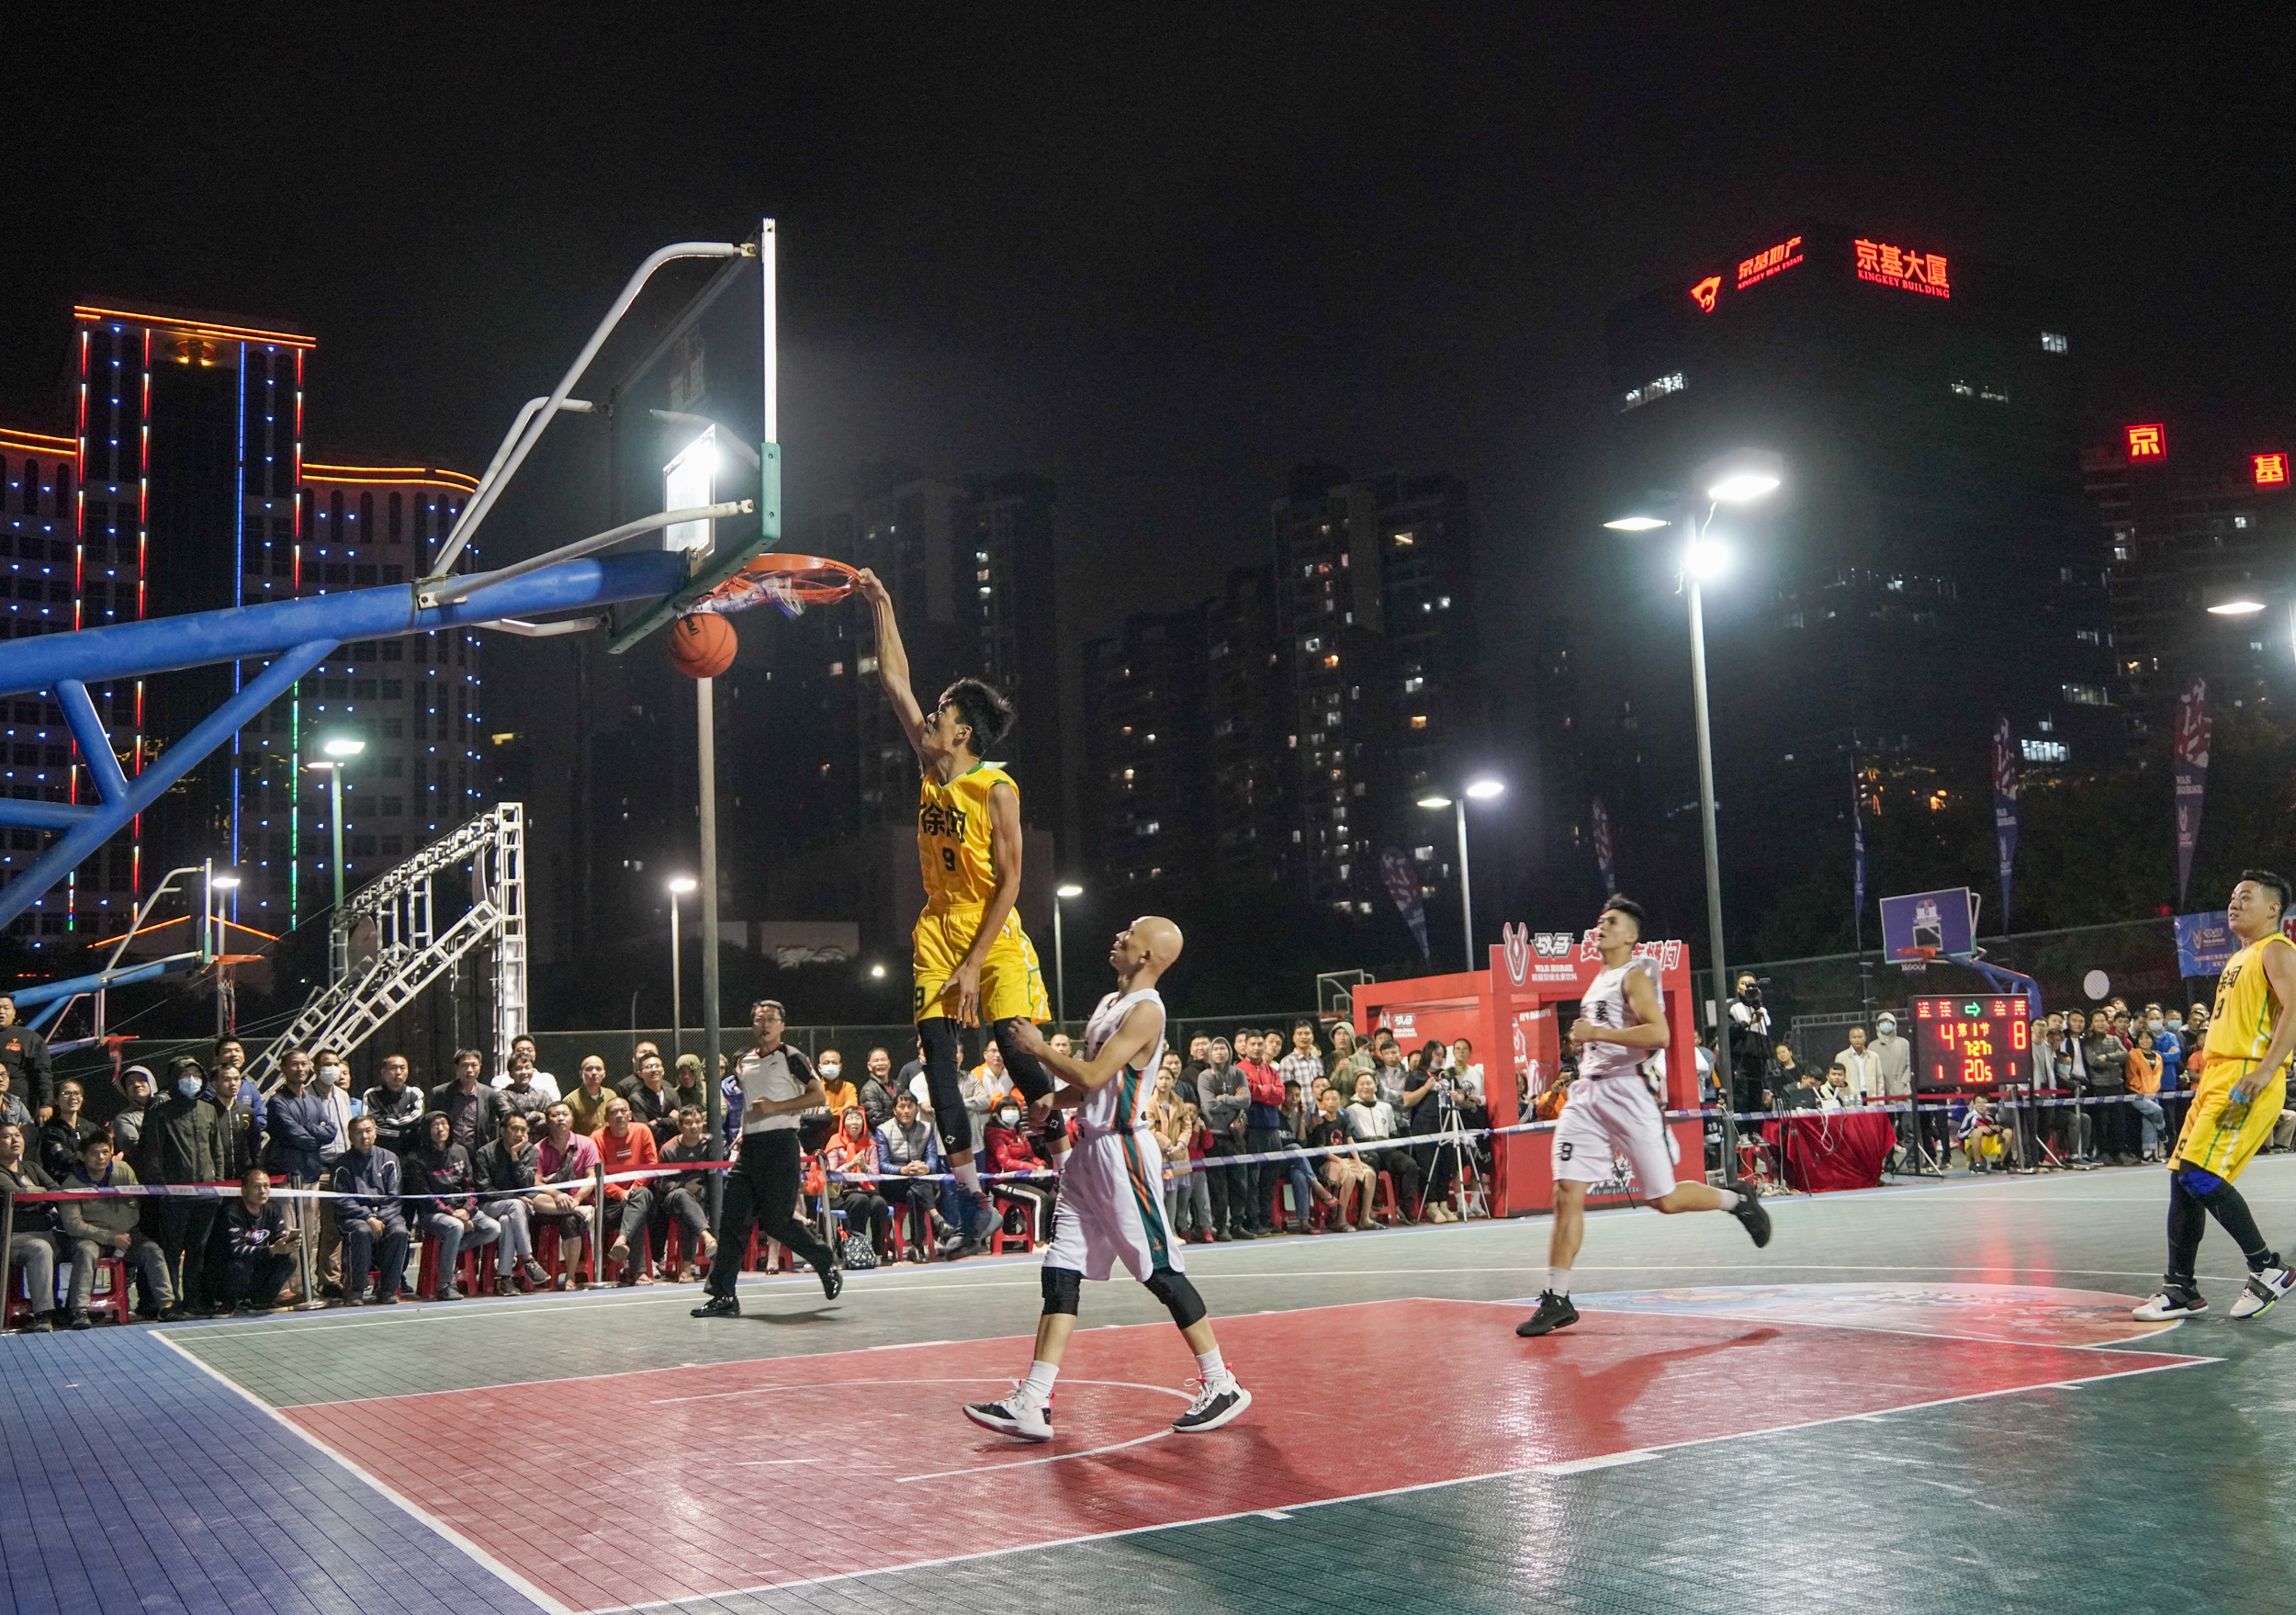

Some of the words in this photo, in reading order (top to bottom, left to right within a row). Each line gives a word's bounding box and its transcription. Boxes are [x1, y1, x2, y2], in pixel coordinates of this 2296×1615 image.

[1738, 235, 1802, 279] 京基地产
[1738, 269, 1766, 289] KINGKEY
[1782, 254, 1804, 271] ESTATE
[1854, 238, 1950, 288] 京基大厦
[1857, 269, 1900, 288] KINGKEY
[1902, 280, 1951, 299] BUILDING
[2129, 427, 2161, 457] 京
[2255, 456, 2285, 485] 基
[942, 846, 956, 872] 9
[1535, 964, 1550, 972] WAR
[1550, 964, 1574, 972] HORSE
[1941, 1023, 1954, 1050] 4
[2013, 1020, 2026, 1050] 8
[1938, 1065, 1944, 1079] 1
[2011, 1062, 2017, 1076] 1
